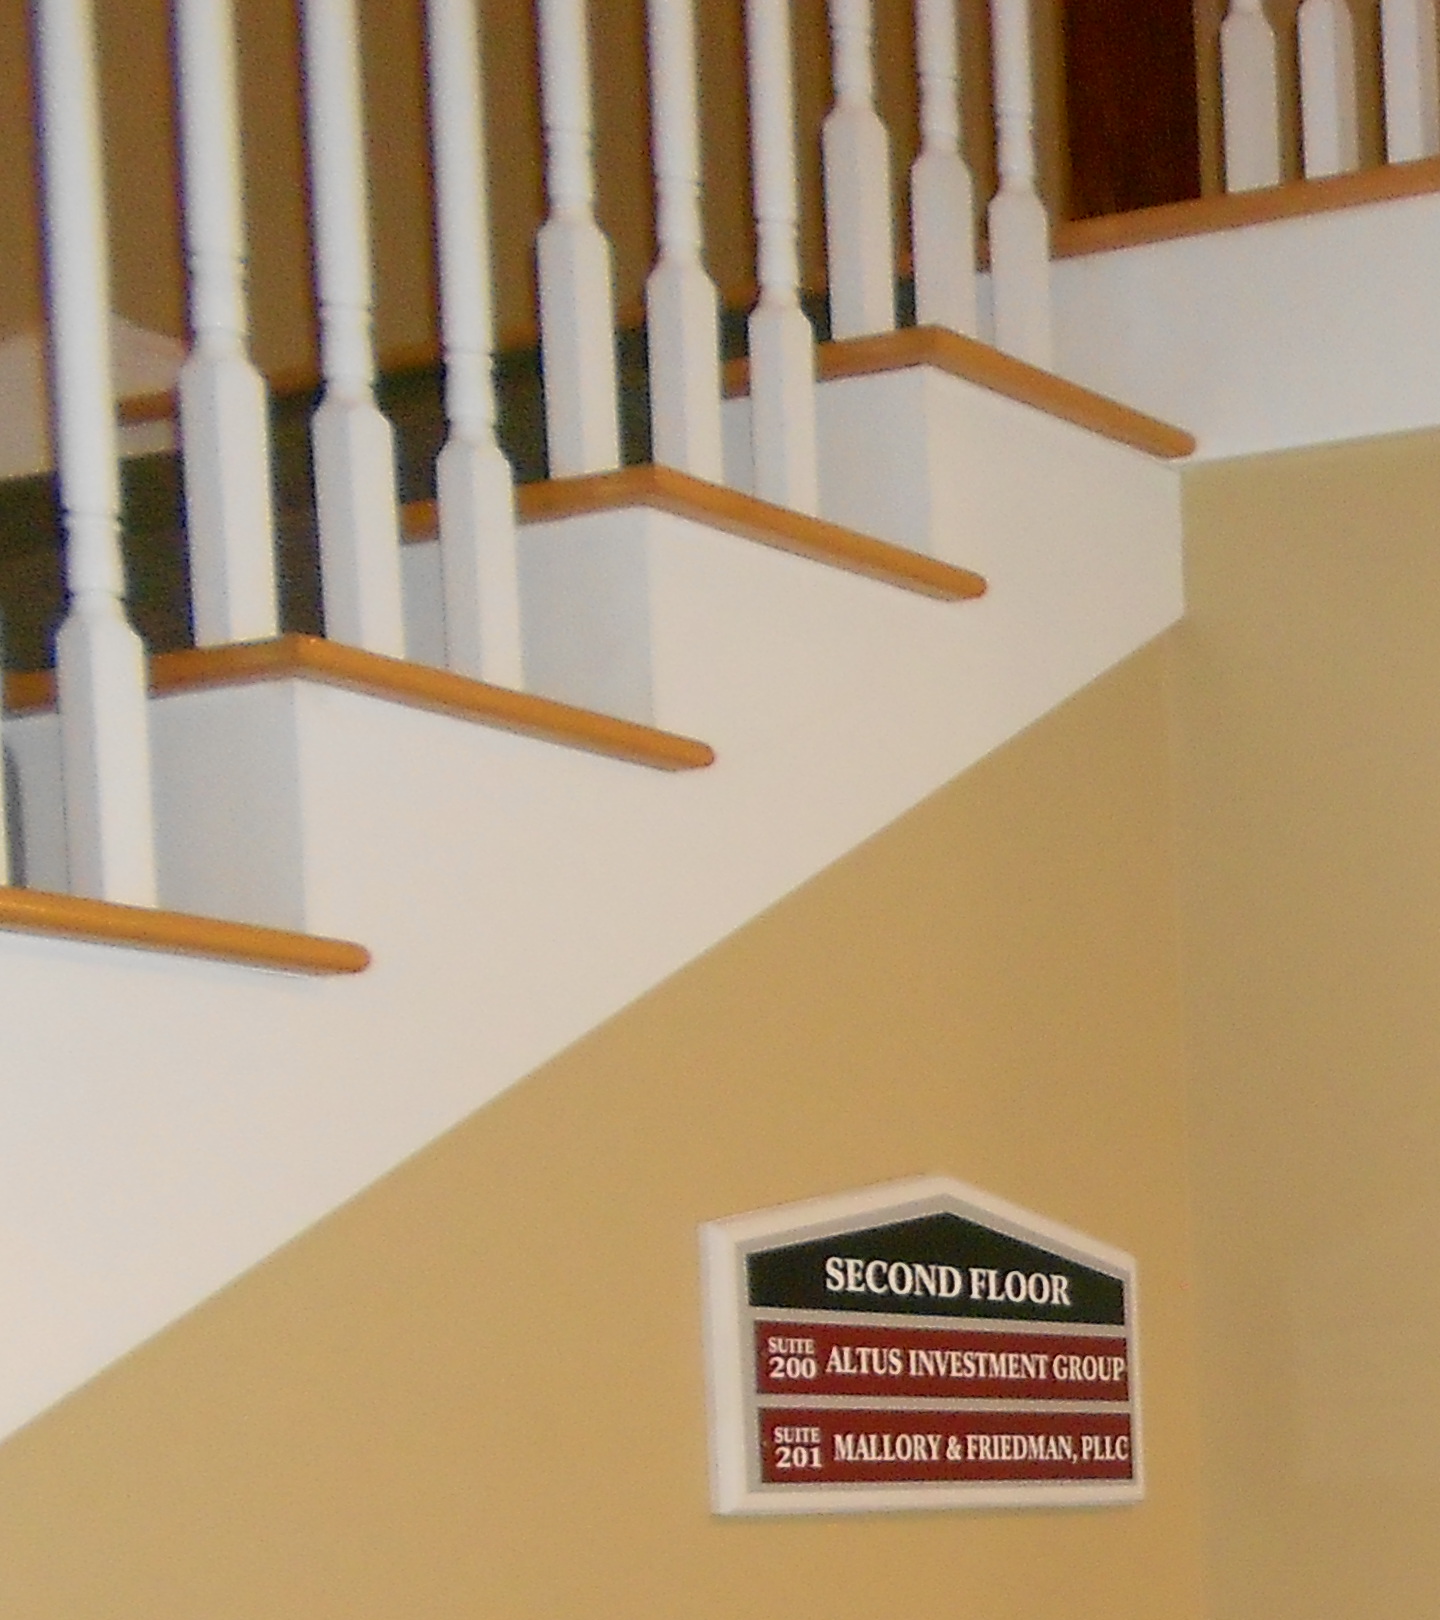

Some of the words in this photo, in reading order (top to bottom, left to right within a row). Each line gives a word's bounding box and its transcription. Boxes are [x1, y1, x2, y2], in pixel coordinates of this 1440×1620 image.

[825, 1256, 962, 1298] SECOND
[969, 1267, 1071, 1306] FLOOR
[767, 1337, 815, 1355] SUITE
[768, 1356, 817, 1379] 200
[825, 1346, 901, 1376] ALTUS
[908, 1350, 1049, 1380] INVESTMENT
[1052, 1354, 1126, 1382] GROUP
[774, 1426, 821, 1444] SUITE
[776, 1447, 823, 1469] 201
[834, 1433, 942, 1462] MALLORY
[946, 1435, 962, 1460] &
[966, 1434, 1078, 1464] FRIEDMAN,
[1082, 1435, 1129, 1461] PLLC
